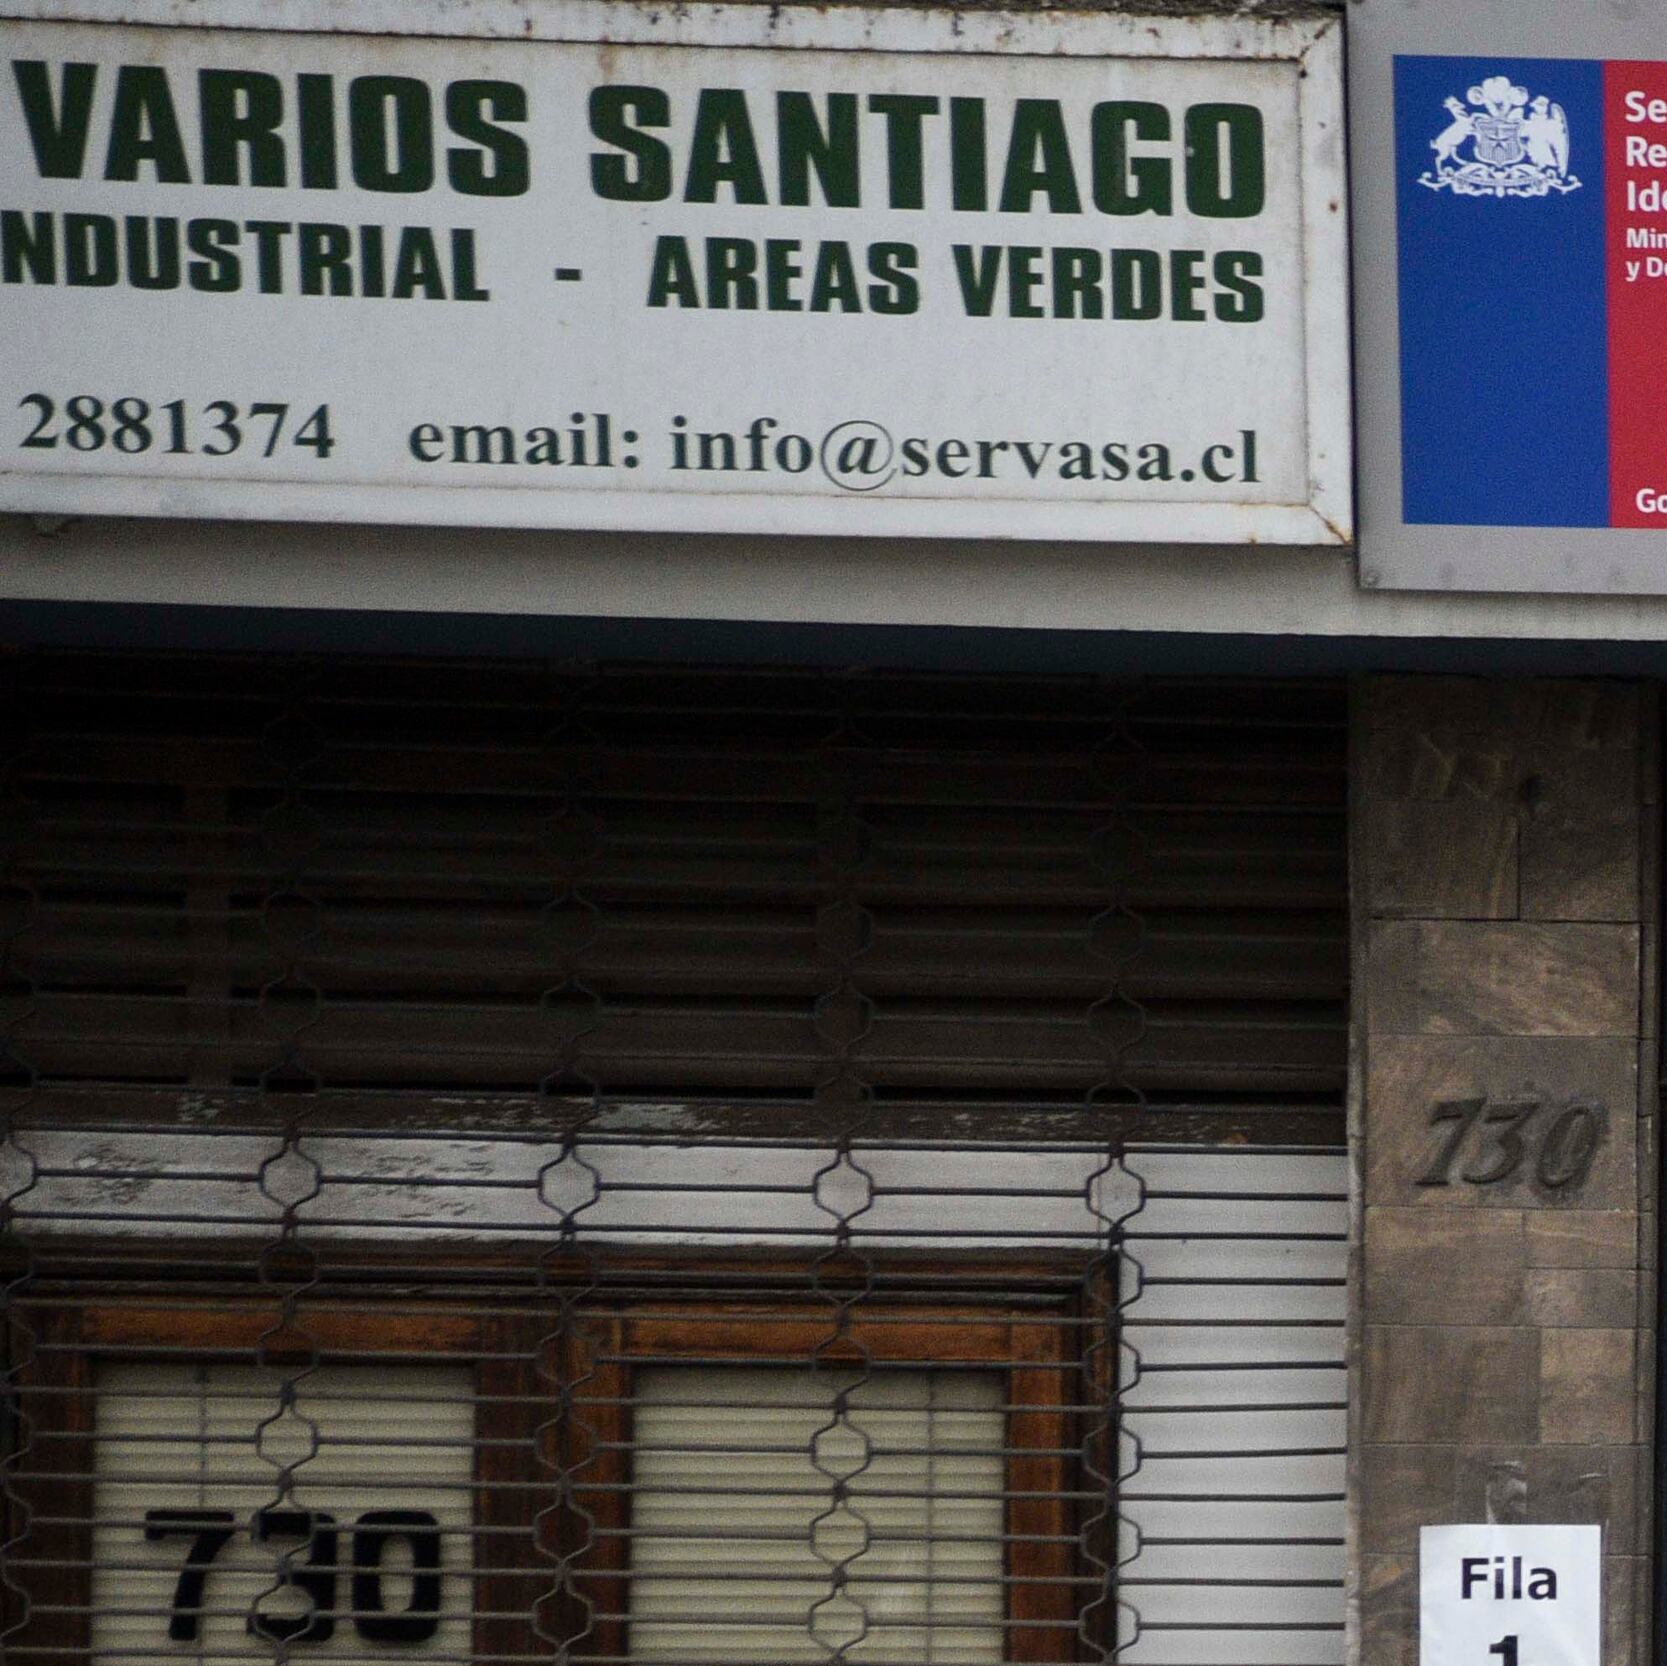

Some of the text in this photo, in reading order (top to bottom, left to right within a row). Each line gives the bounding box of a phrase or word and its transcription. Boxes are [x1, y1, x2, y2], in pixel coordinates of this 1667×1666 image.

[11, 60, 1265, 218] VARIOS SANTIAGO
[0, 210, 489, 301] NDUSTRIAL
[647, 235, 919, 315] AREAS
[952, 245, 1264, 322] VERDES
[1626, 262, 1640, 282] y
[20, 393, 1258, 491] 2881374 email: info@servasa.cl
[1416, 1098, 1607, 1188] 730
[143, 1509, 442, 1643] 730
[1462, 1557, 1556, 1600] Fila
